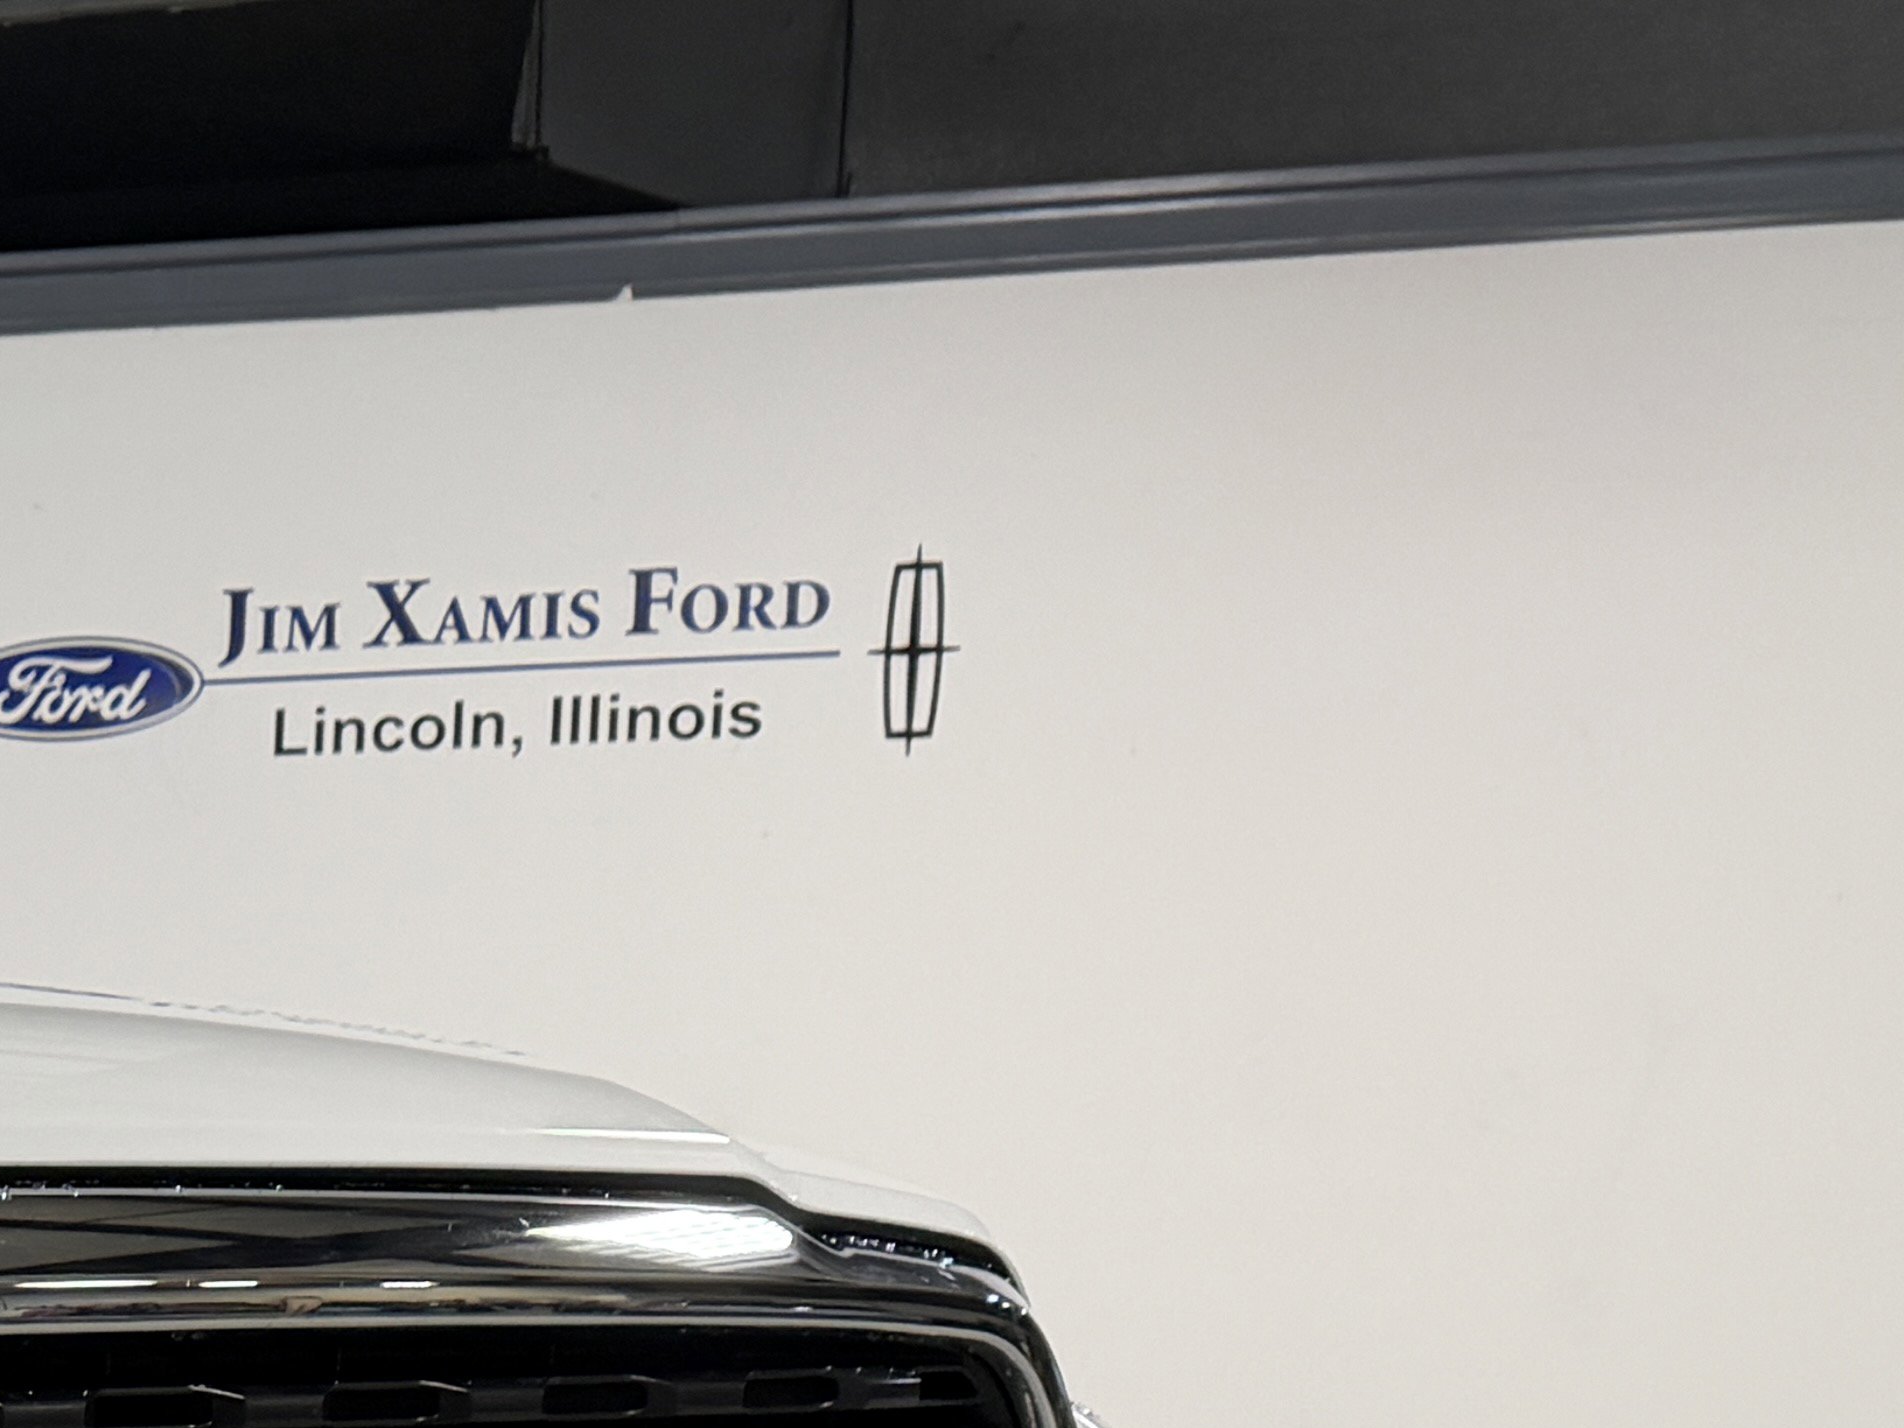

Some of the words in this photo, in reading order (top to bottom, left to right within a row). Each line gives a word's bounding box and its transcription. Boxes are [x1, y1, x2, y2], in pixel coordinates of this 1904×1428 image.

[218, 587, 340, 668] JIM
[363, 578, 600, 648] XAMIS
[625, 567, 830, 636] FORD
[273, 700, 524, 757] Lincoln,
[550, 689, 762, 745] Illinois
